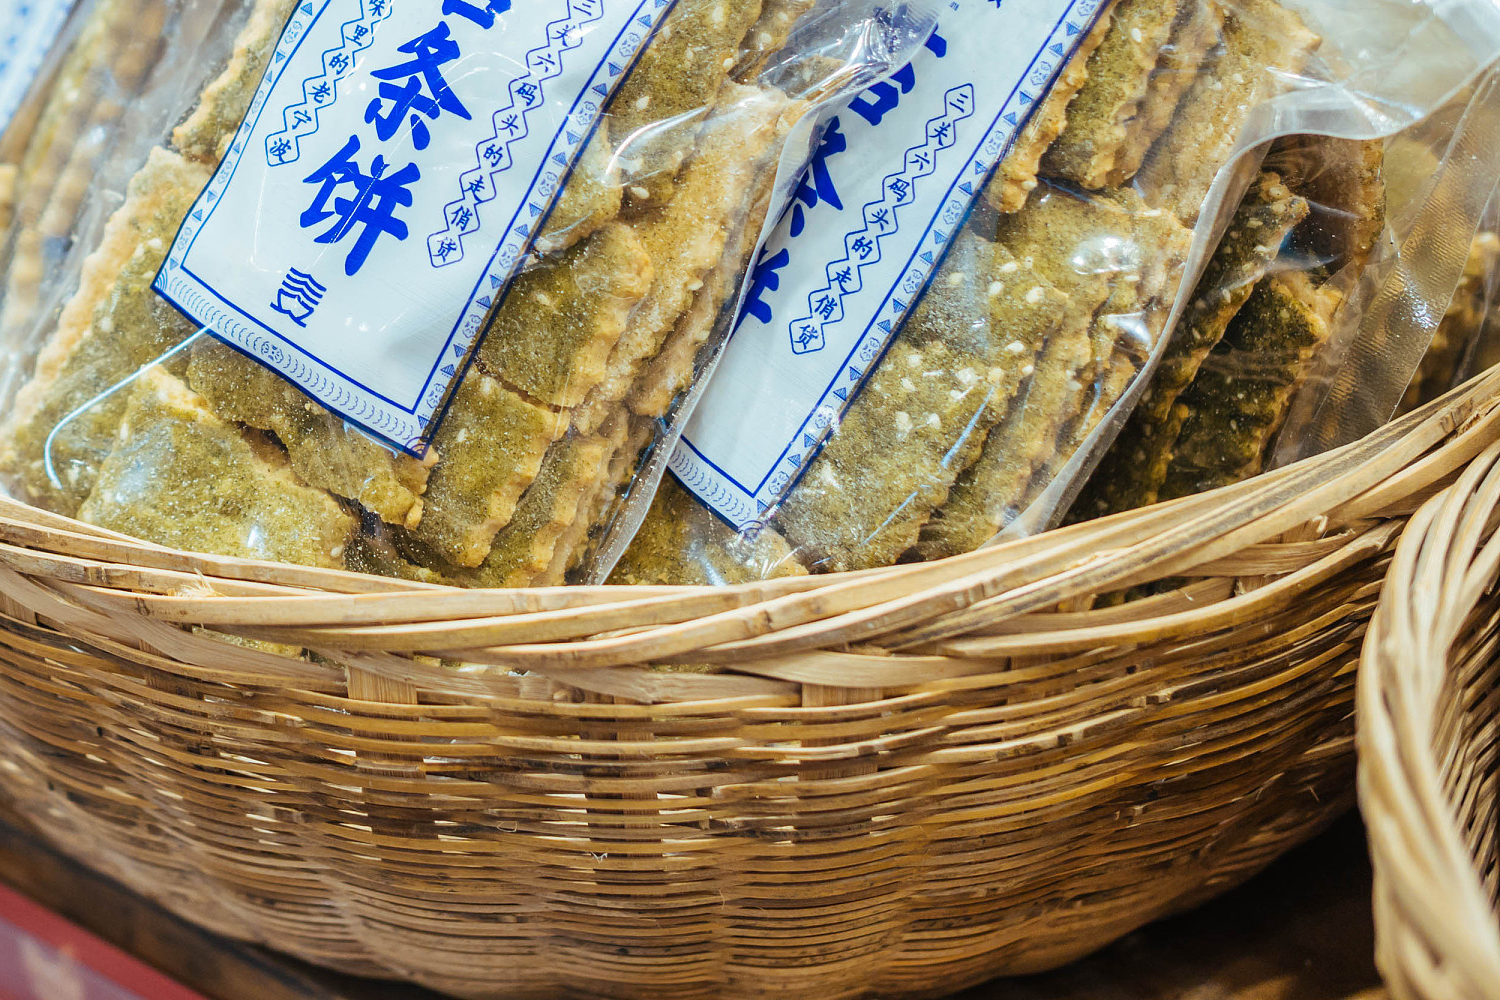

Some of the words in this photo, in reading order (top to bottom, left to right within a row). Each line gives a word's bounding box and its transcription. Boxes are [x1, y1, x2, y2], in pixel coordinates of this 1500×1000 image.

[794, 92, 969, 350] 三关六码头的走俏货
